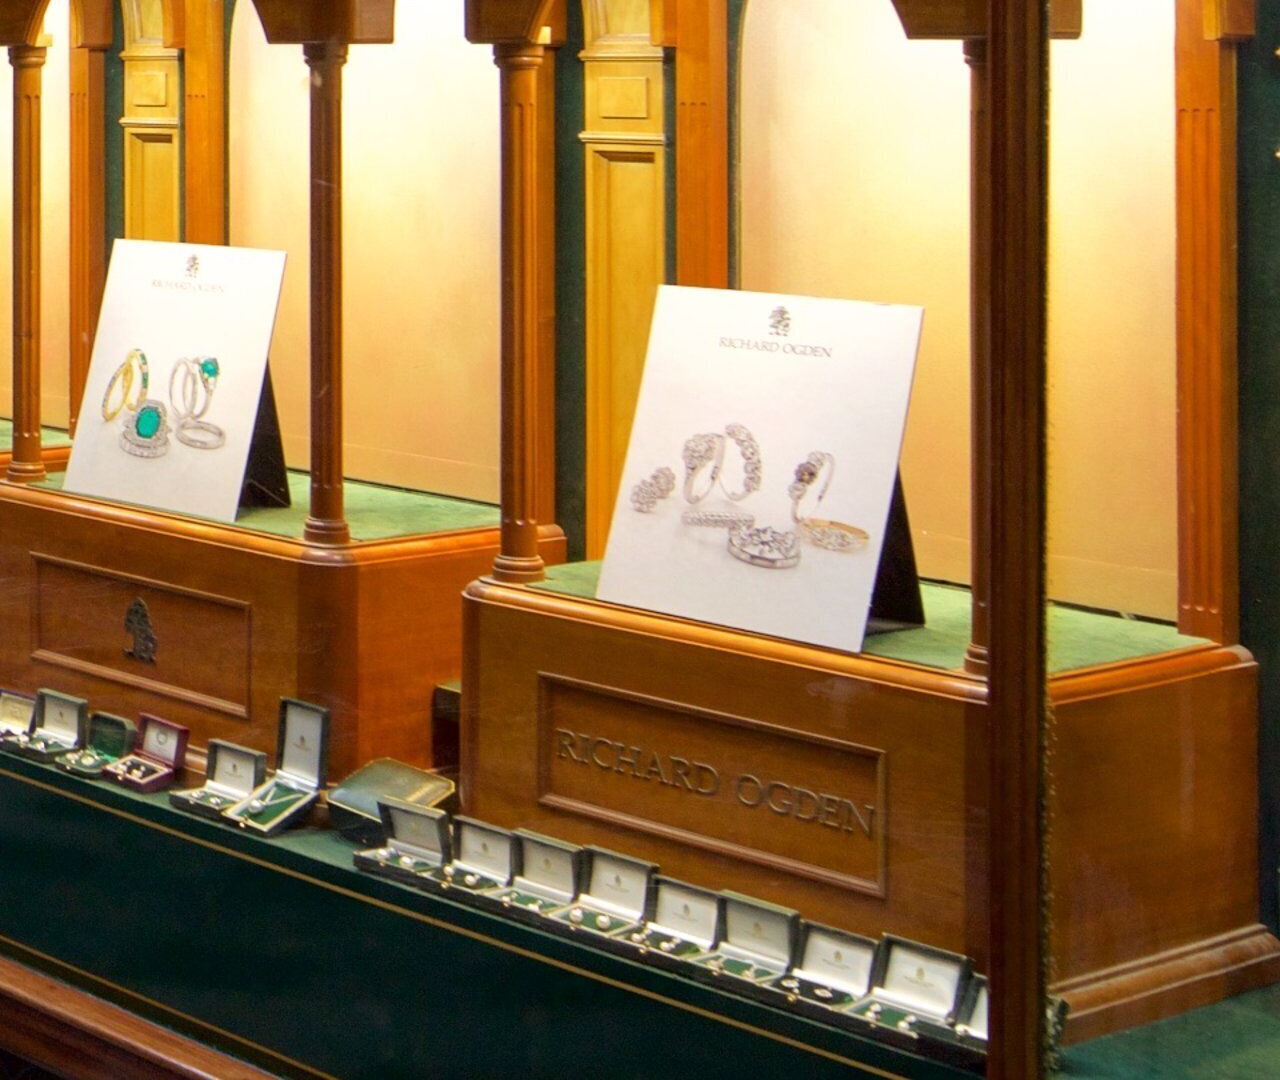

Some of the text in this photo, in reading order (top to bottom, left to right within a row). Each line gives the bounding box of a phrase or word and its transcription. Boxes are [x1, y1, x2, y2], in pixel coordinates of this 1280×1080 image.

[719, 336, 832, 358] RICHARD OGDEN
[555, 728, 876, 840] RICHARD OGDEN
